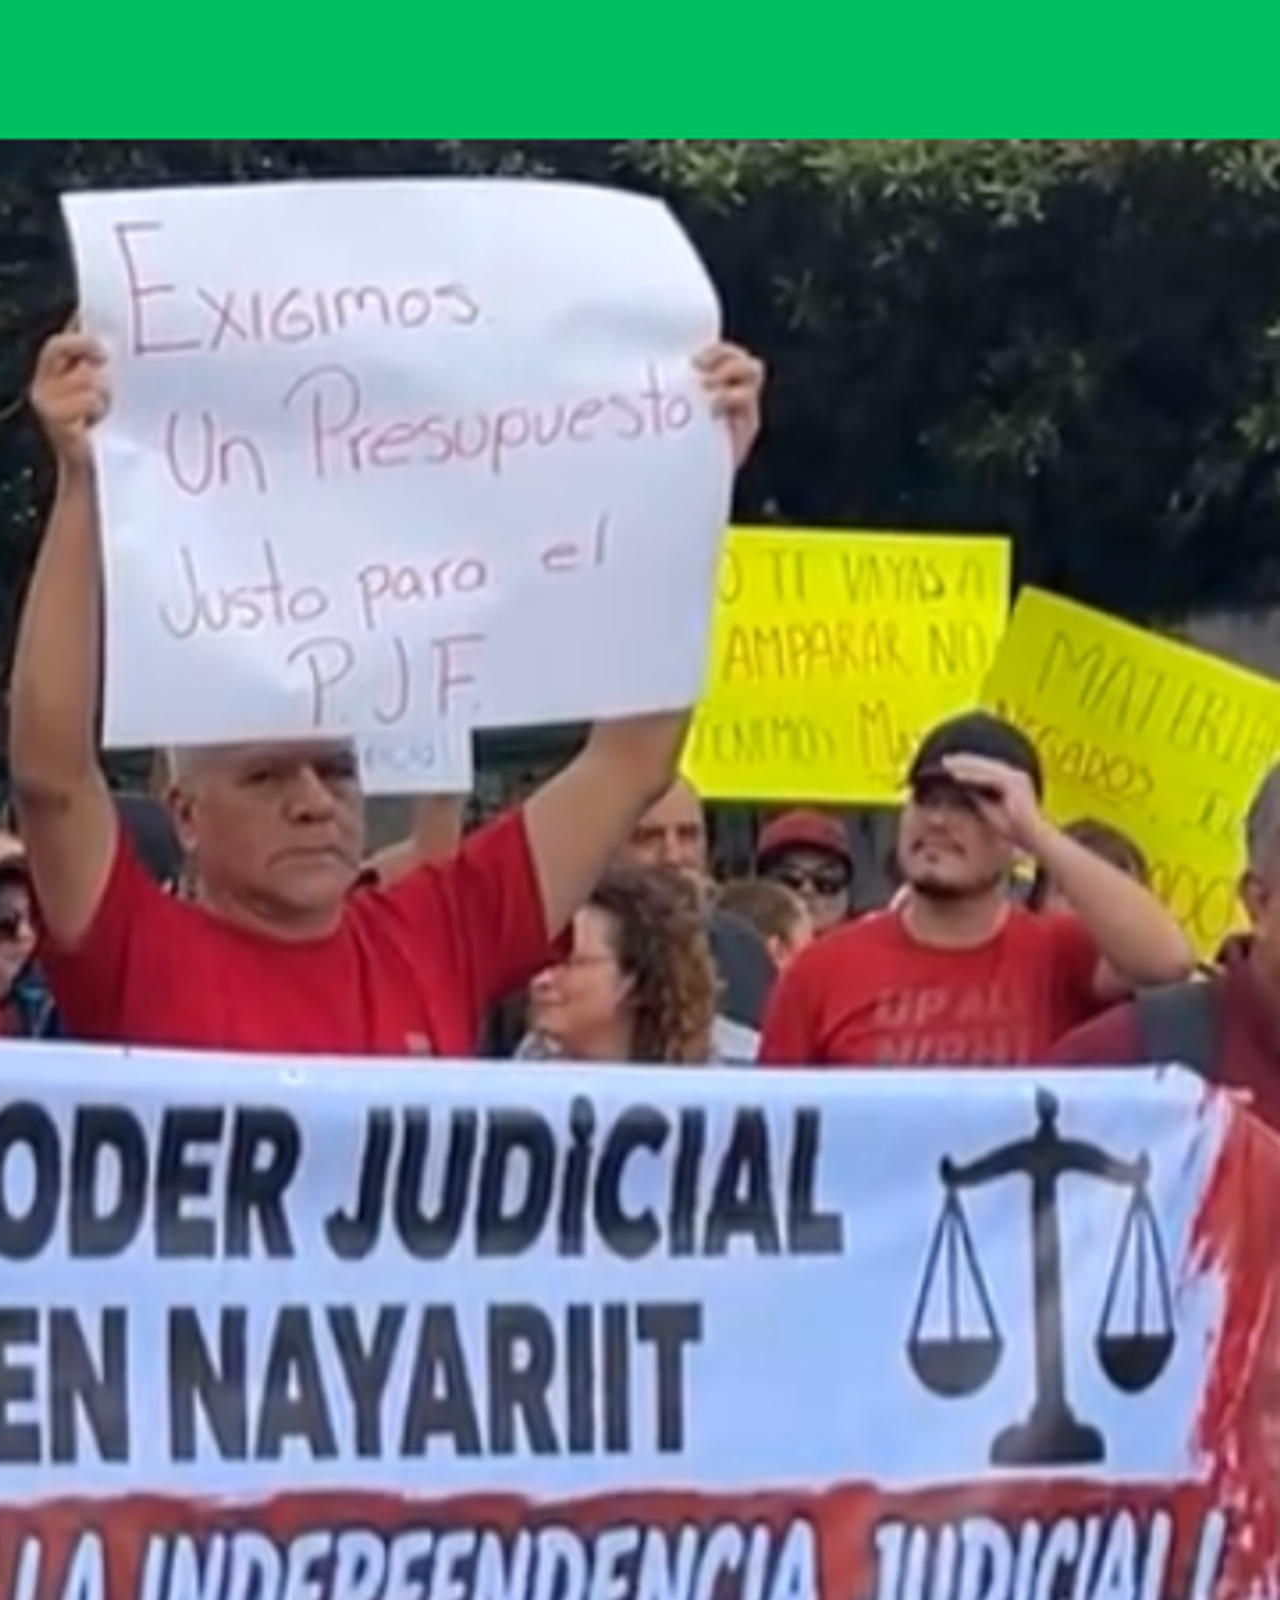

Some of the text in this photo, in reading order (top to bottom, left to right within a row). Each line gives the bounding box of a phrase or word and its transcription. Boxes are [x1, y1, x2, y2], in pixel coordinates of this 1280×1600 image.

[166, 363, 693, 497] Un Presupuesto
[159, 513, 610, 640] Justo para el
[718, 548, 742, 605] O
[722, 619, 989, 682] AMPARAR NO
[167, 1301, 703, 1464] NAYARIIT
